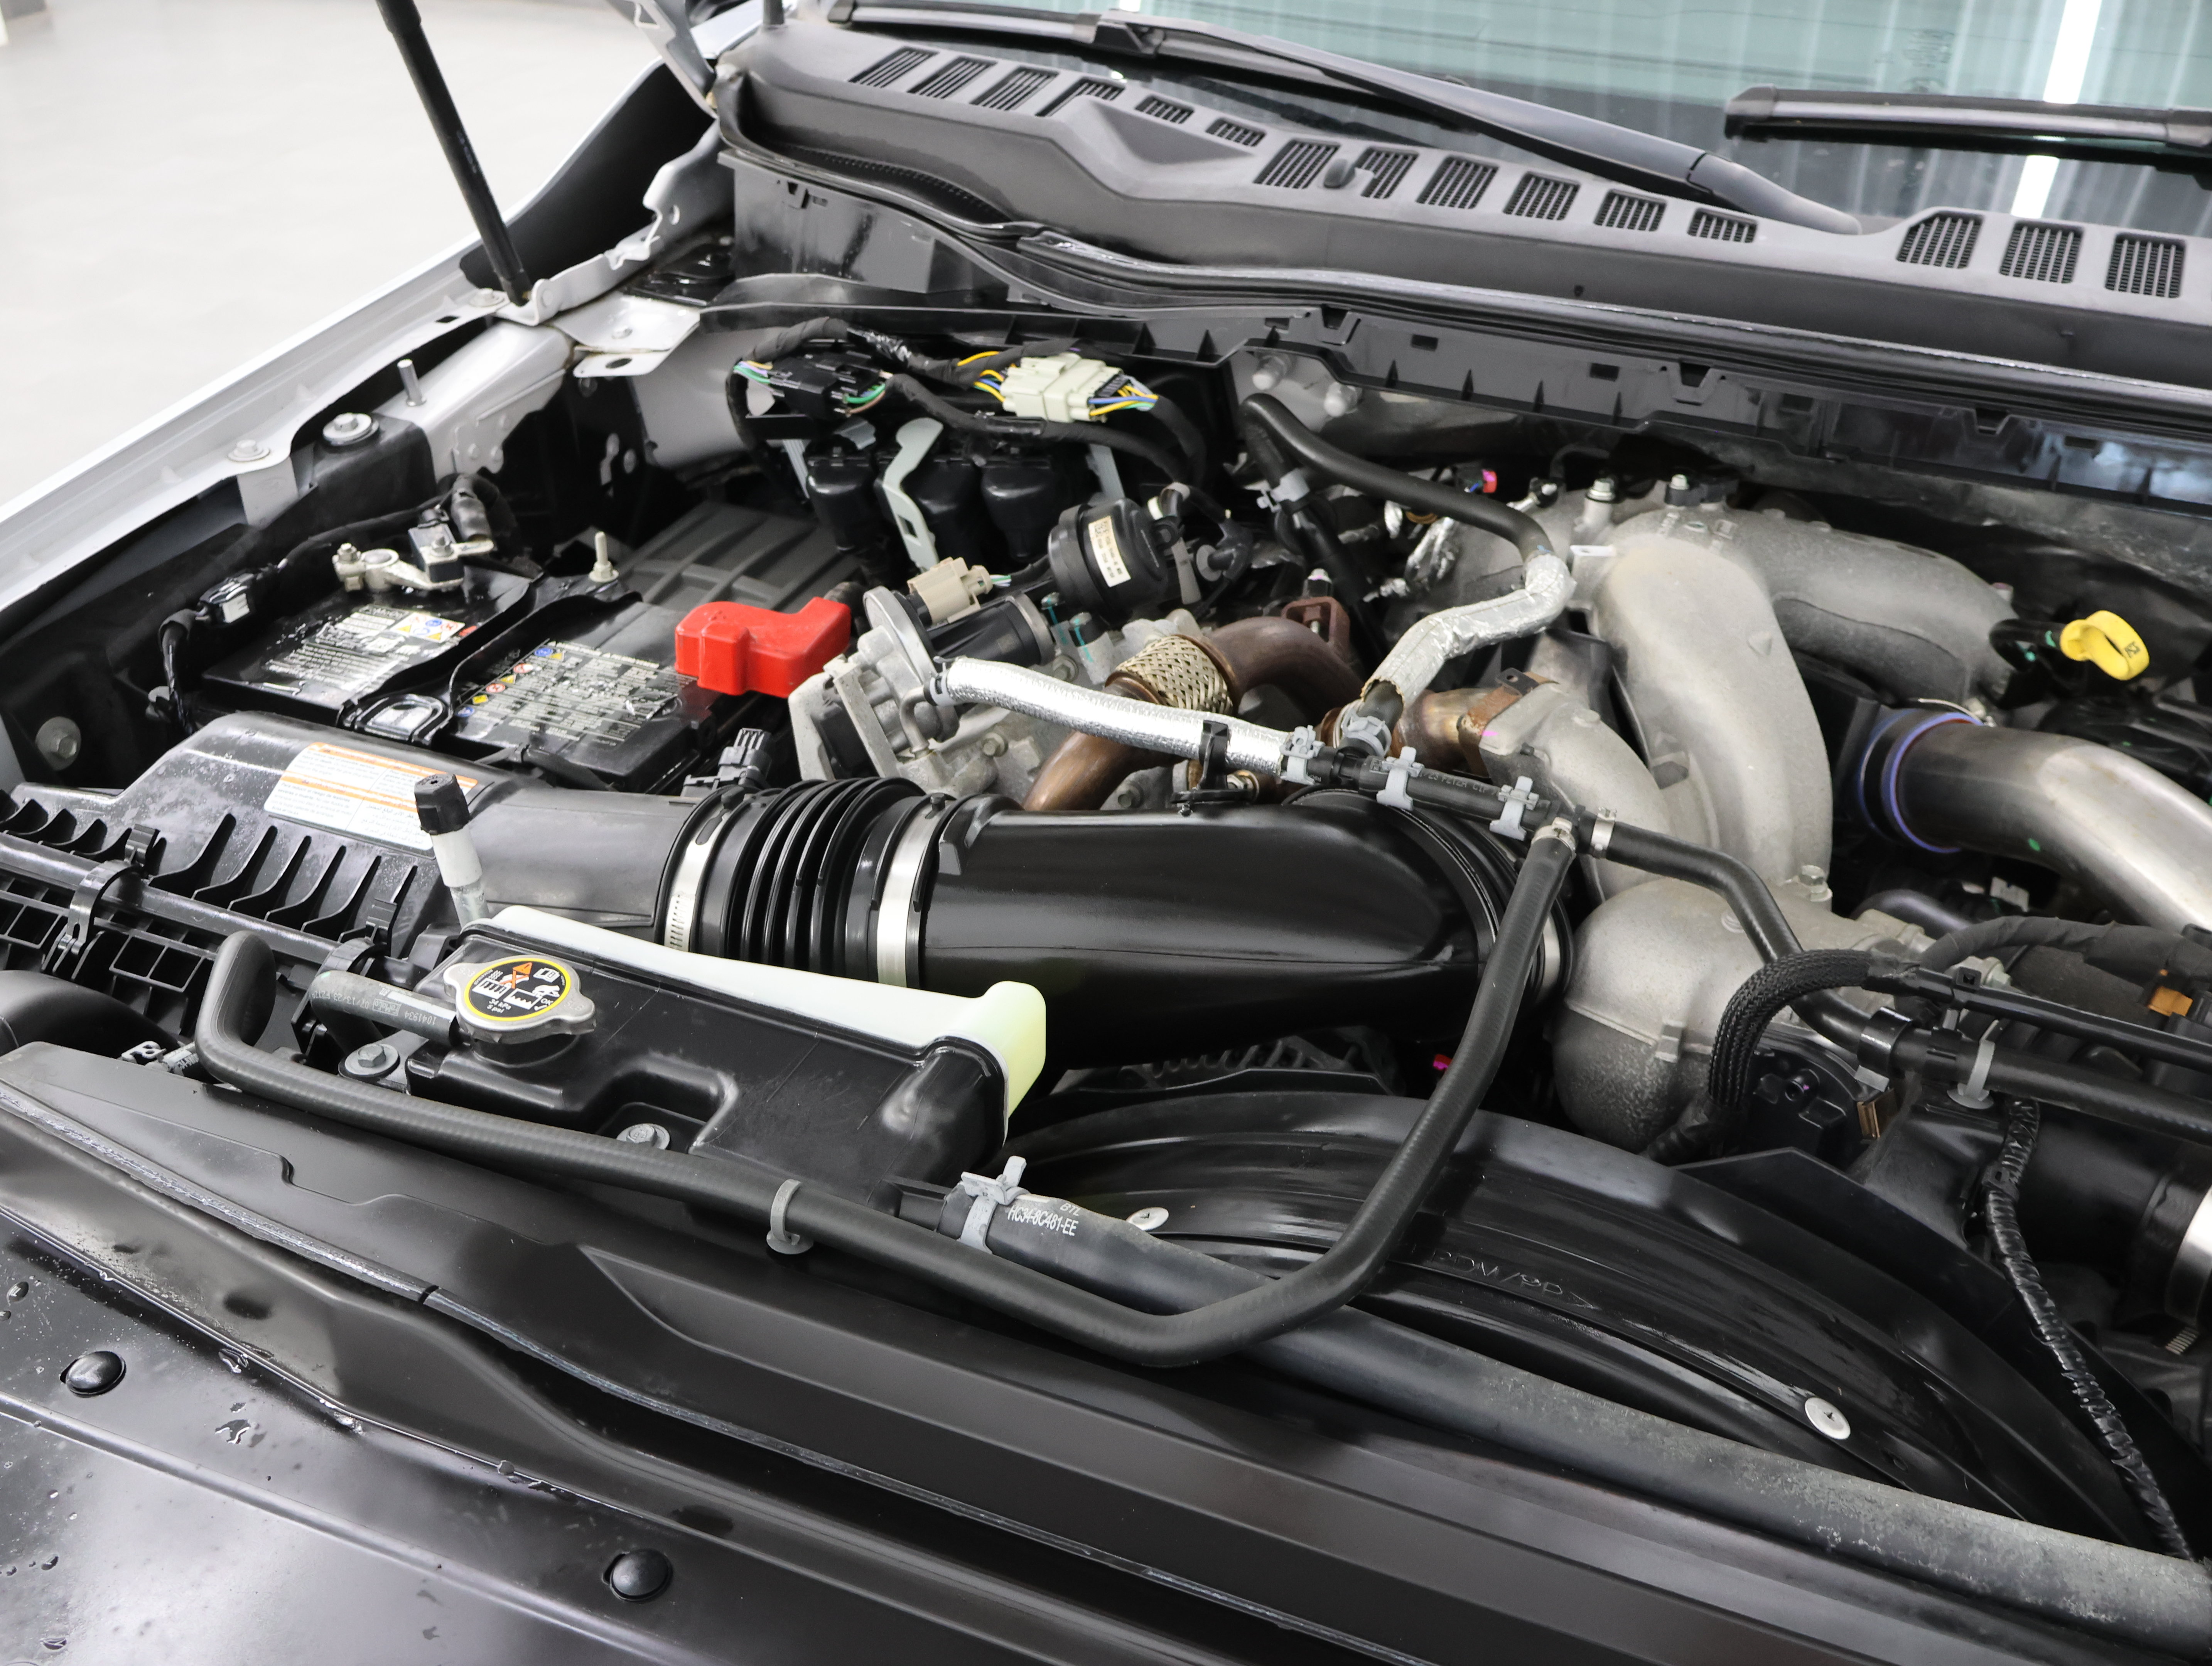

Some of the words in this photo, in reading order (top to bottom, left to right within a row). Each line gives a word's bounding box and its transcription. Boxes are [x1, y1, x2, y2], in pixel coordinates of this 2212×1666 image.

[374, 1000, 399, 1015] FoMoCo
[498, 1001, 511, 1010] kPa
[540, 998, 553, 1006] OK
[404, 1010, 437, 1026] 1041934
[1060, 1202, 1081, 1217] BTL
[1007, 1205, 1079, 1236] HC34-8C481-EE
